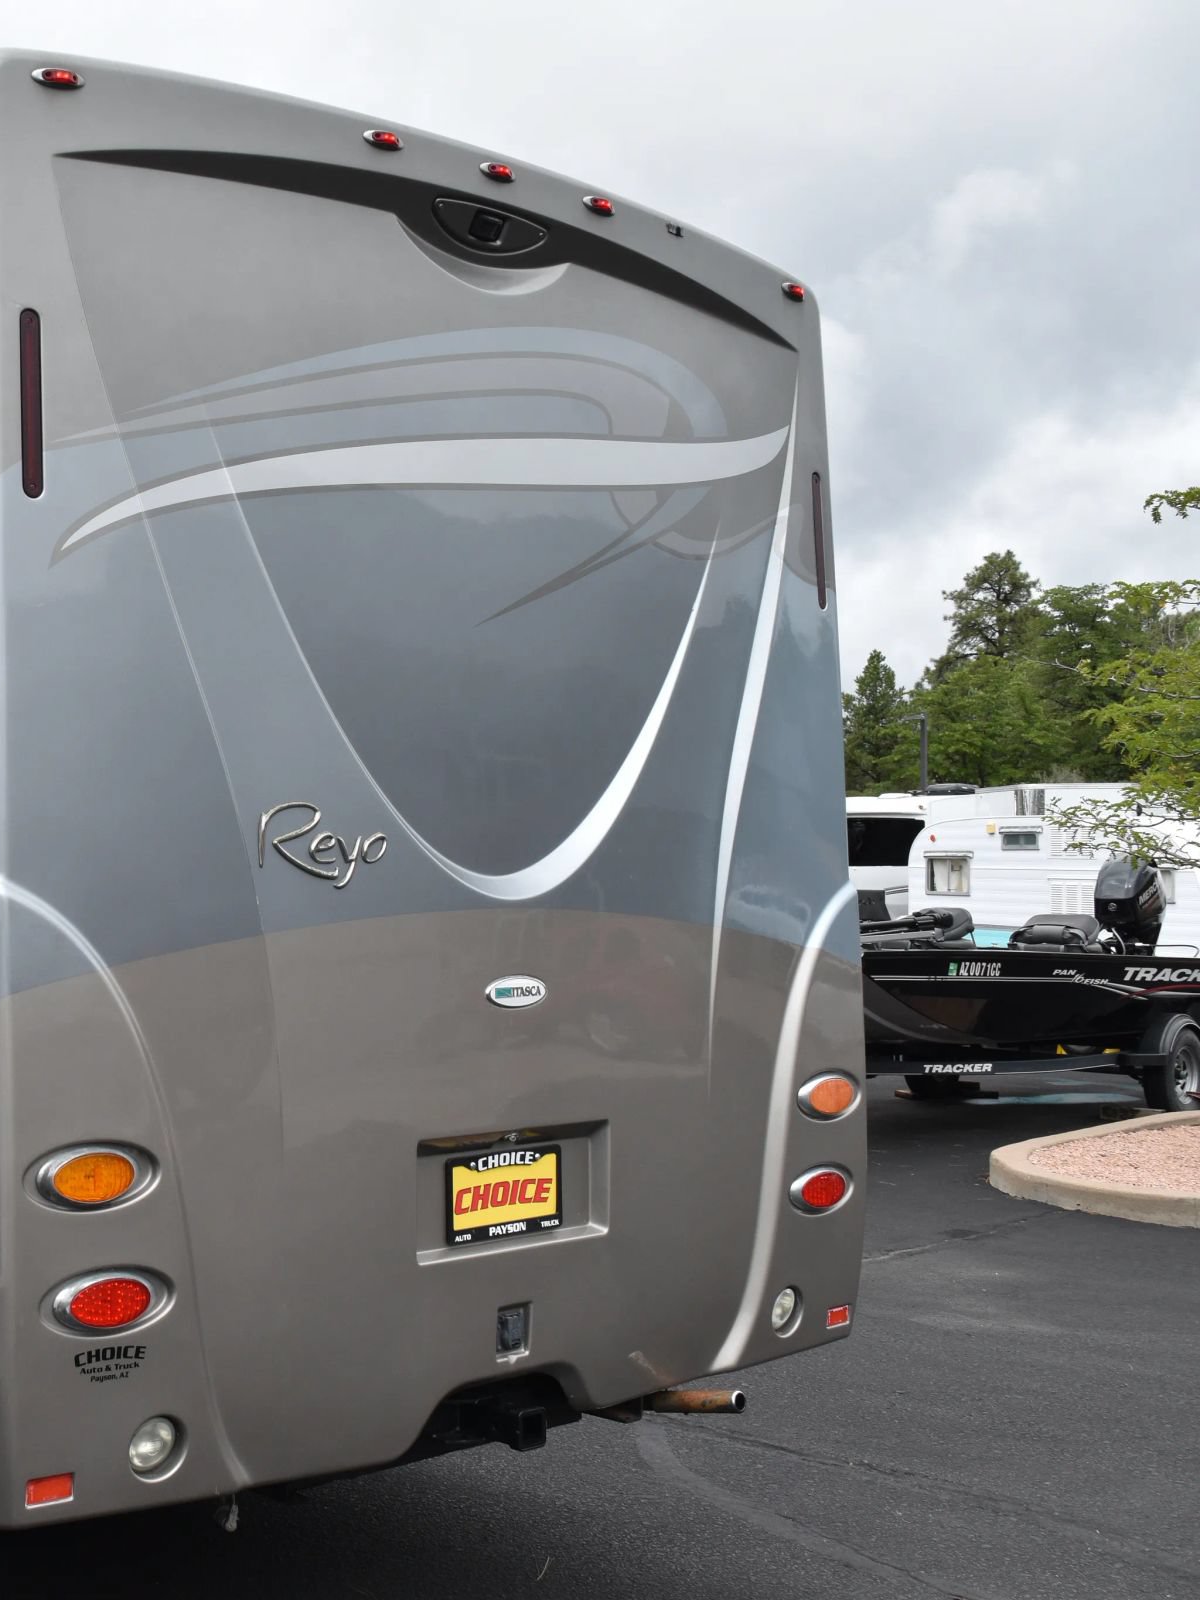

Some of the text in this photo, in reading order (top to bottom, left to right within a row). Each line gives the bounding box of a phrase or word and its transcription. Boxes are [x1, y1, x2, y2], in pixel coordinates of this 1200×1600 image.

[258, 801, 387, 889] Reyo
[512, 985, 541, 997] ITASCA
[923, 1063, 993, 1073] TRACKER
[477, 1151, 534, 1171] CHOICE
[454, 1178, 553, 1215] CHOICE
[455, 1219, 559, 1242] AUTO PAYSON TRUCK
[74, 1345, 147, 1367] CHOICE
[114, 1361, 140, 1370] Truck
[90, 1374, 118, 1383] Payson,
